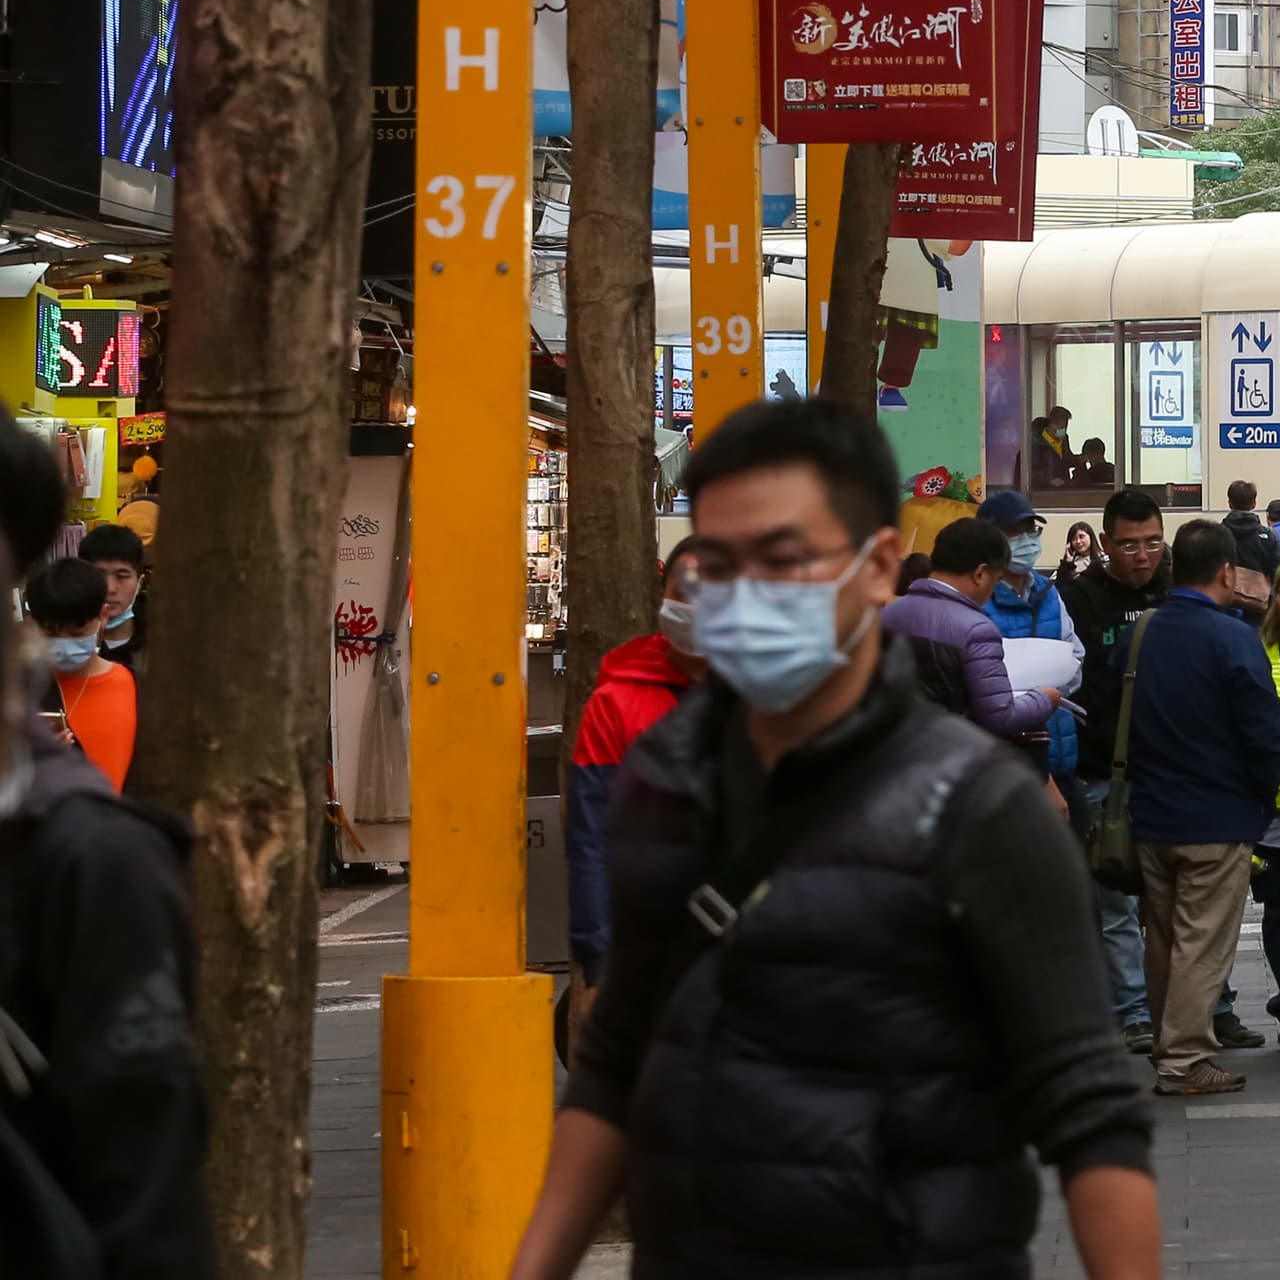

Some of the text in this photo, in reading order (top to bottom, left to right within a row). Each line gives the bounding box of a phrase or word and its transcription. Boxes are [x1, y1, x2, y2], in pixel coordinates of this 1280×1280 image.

[444, 27, 499, 90] H
[424, 175, 516, 241] 37
[705, 224, 739, 264] H
[696, 315, 752, 355] 39
[1245, 426, 1278, 444] 20m
